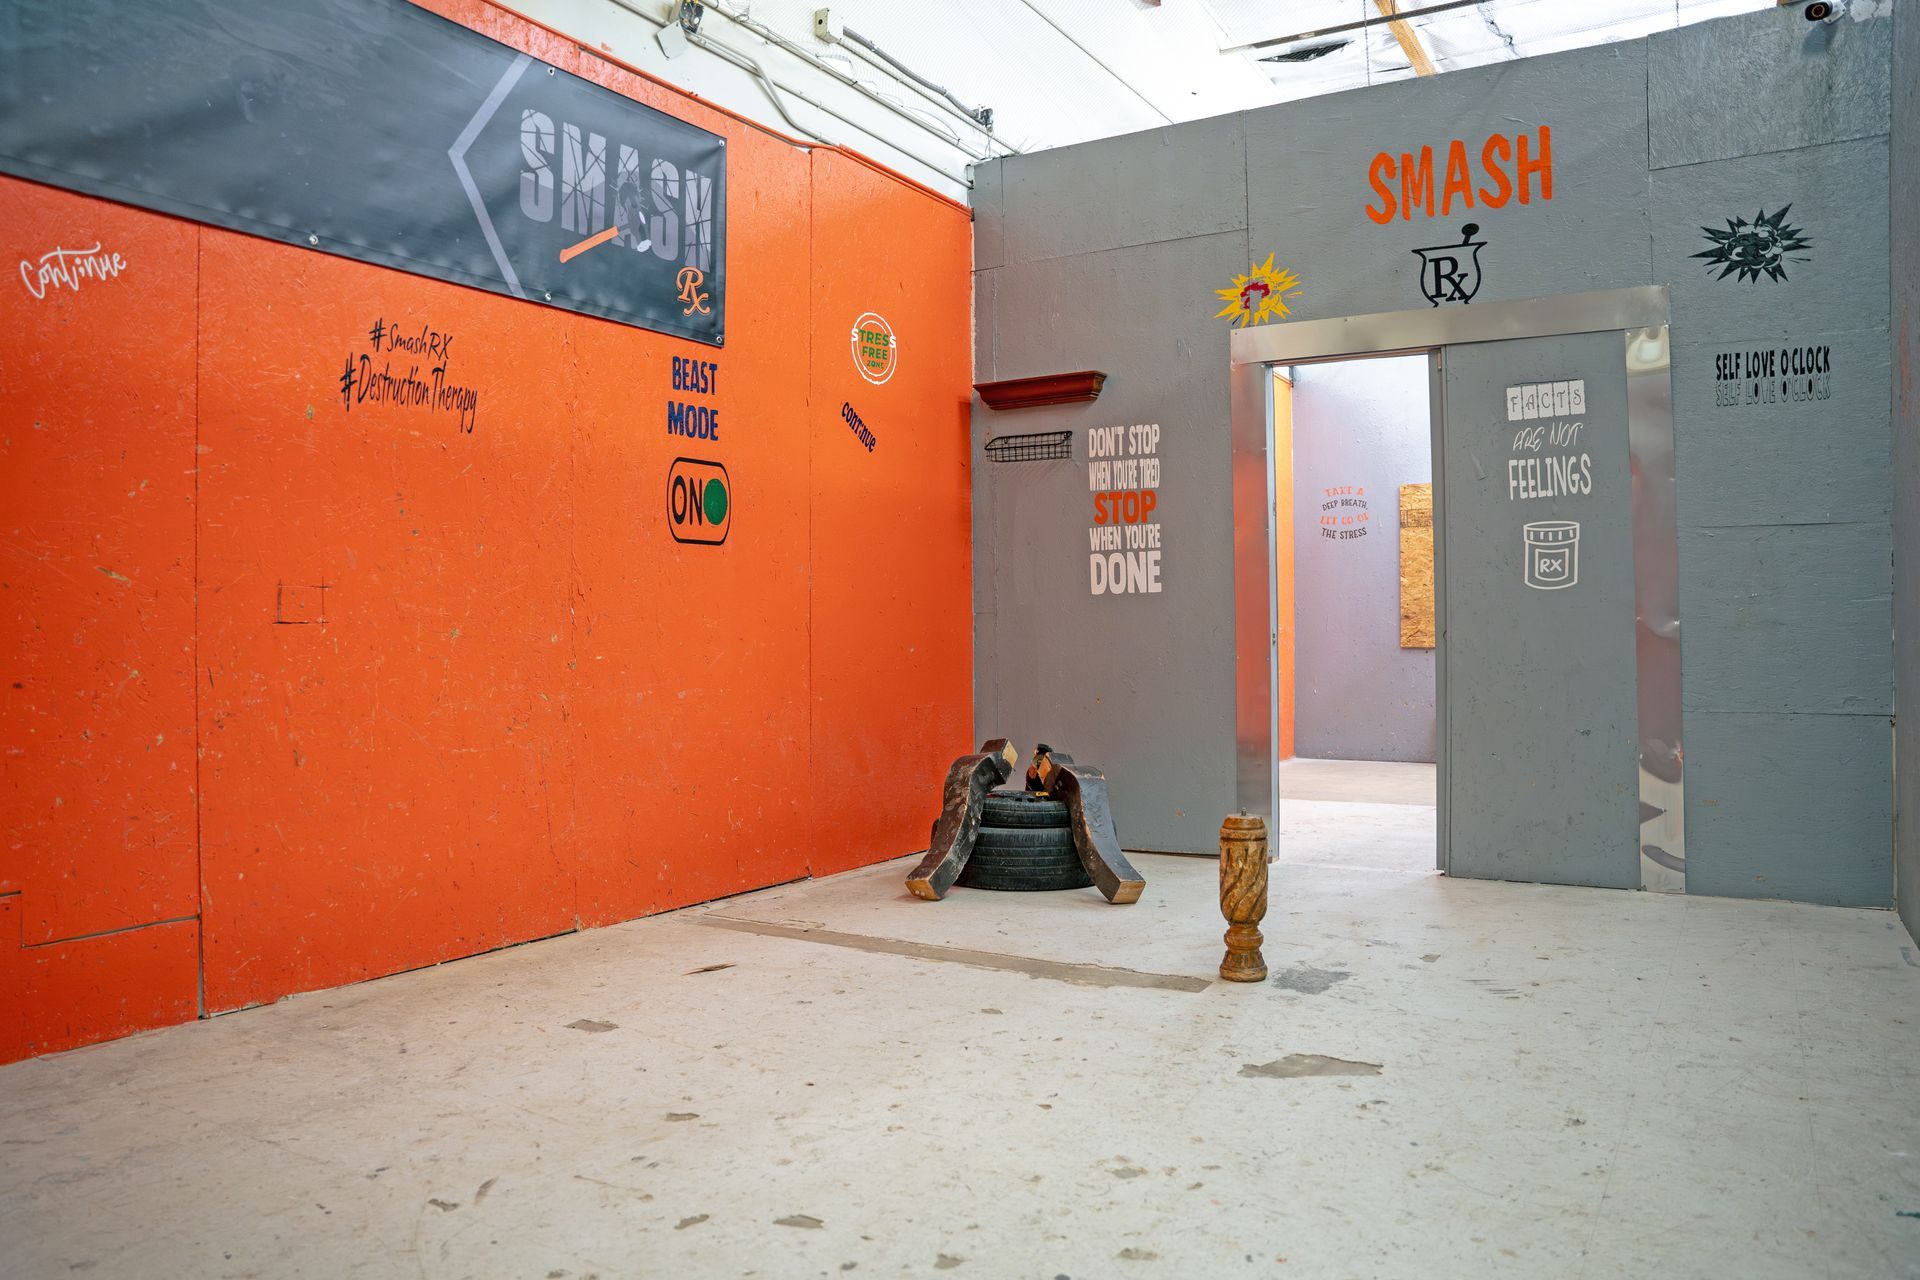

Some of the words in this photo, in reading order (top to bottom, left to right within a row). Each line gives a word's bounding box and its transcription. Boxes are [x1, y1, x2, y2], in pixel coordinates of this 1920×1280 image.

[519, 108, 712, 273] SMASH
[1365, 125, 1553, 225] SMASH
[851, 327, 897, 349] STRESS
[862, 346, 888, 361] FREE
[671, 356, 717, 395] BEAST
[866, 360, 884, 369] ZONE
[1716, 352, 1741, 381] SELF
[1746, 350, 1775, 379] LOVE
[1508, 386, 1584, 416] FACTS
[1746, 377, 1776, 406] LOVE
[668, 400, 719, 441] MODE
[1088, 426, 1125, 458] DON'T
[1128, 423, 1160, 456] STOP
[1513, 426, 1545, 451] ARE
[1550, 422, 1583, 447] NOT
[1088, 460, 1111, 491] WHEN
[1113, 459, 1137, 490] YOU'RE
[1139, 457, 1160, 489] TIRED
[1508, 453, 1592, 501] FEELINGS
[671, 475, 703, 526] ON
[1094, 490, 1156, 525] STOP
[1322, 500, 1339, 511] DEEP
[1089, 526, 1122, 551] WHEN
[1125, 524, 1161, 549] YOU'RE
[1322, 528, 1337, 540] THE
[1339, 527, 1367, 540] STRESS
[1089, 551, 1163, 595] DONE
[1539, 558, 1562, 573] RX
